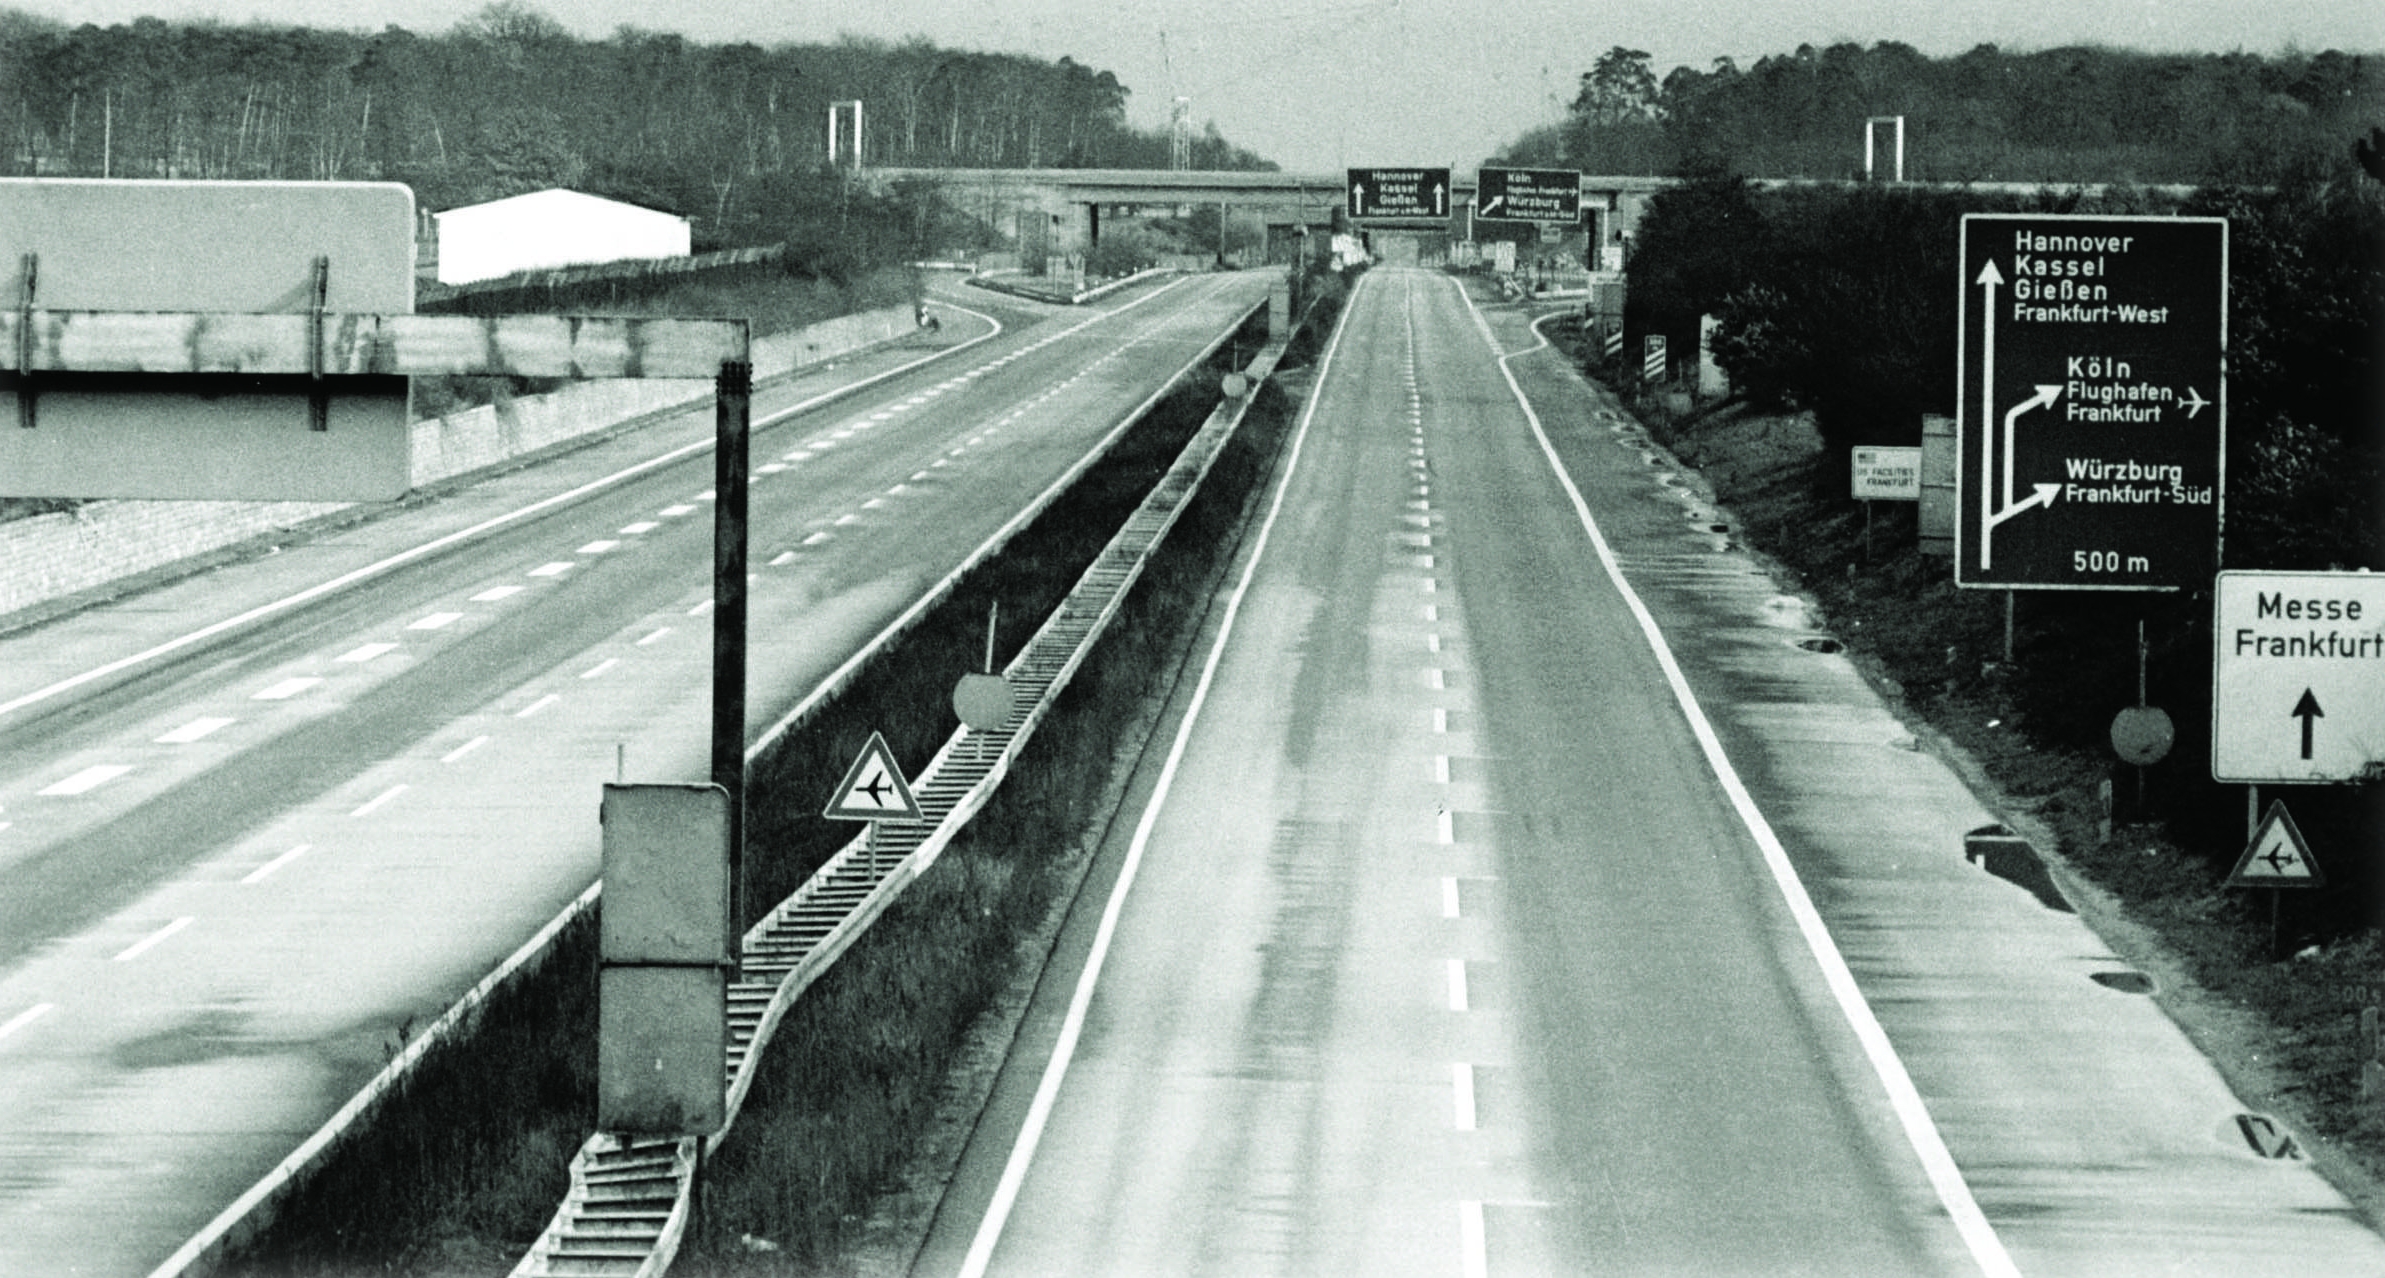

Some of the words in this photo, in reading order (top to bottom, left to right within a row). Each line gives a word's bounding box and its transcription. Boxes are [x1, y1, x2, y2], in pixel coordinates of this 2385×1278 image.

[1372, 171, 1424, 181] Hannover
[1507, 171, 1532, 183] Köln
[1380, 183, 1418, 193] Kassel
[1380, 194, 1418, 205] Gießen
[1506, 195, 1560, 210] Würzburg
[2015, 230, 2134, 253] Hannover
[2015, 254, 2105, 277] Kassel
[2014, 278, 2108, 301] Gießen
[2014, 302, 2169, 324] Frankfurt-West
[2067, 356, 2131, 379] Köln
[2067, 380, 2173, 404] Flughafen
[2067, 402, 2162, 423] Frankfurt
[2066, 458, 2182, 486] Würzburg
[2066, 483, 2212, 504] Frankfurt-Süd
[2074, 551, 2120, 572] 500
[2127, 556, 2149, 573] m
[2257, 591, 2363, 621] Messe
[2236, 628, 2385, 659] Frankfurt
